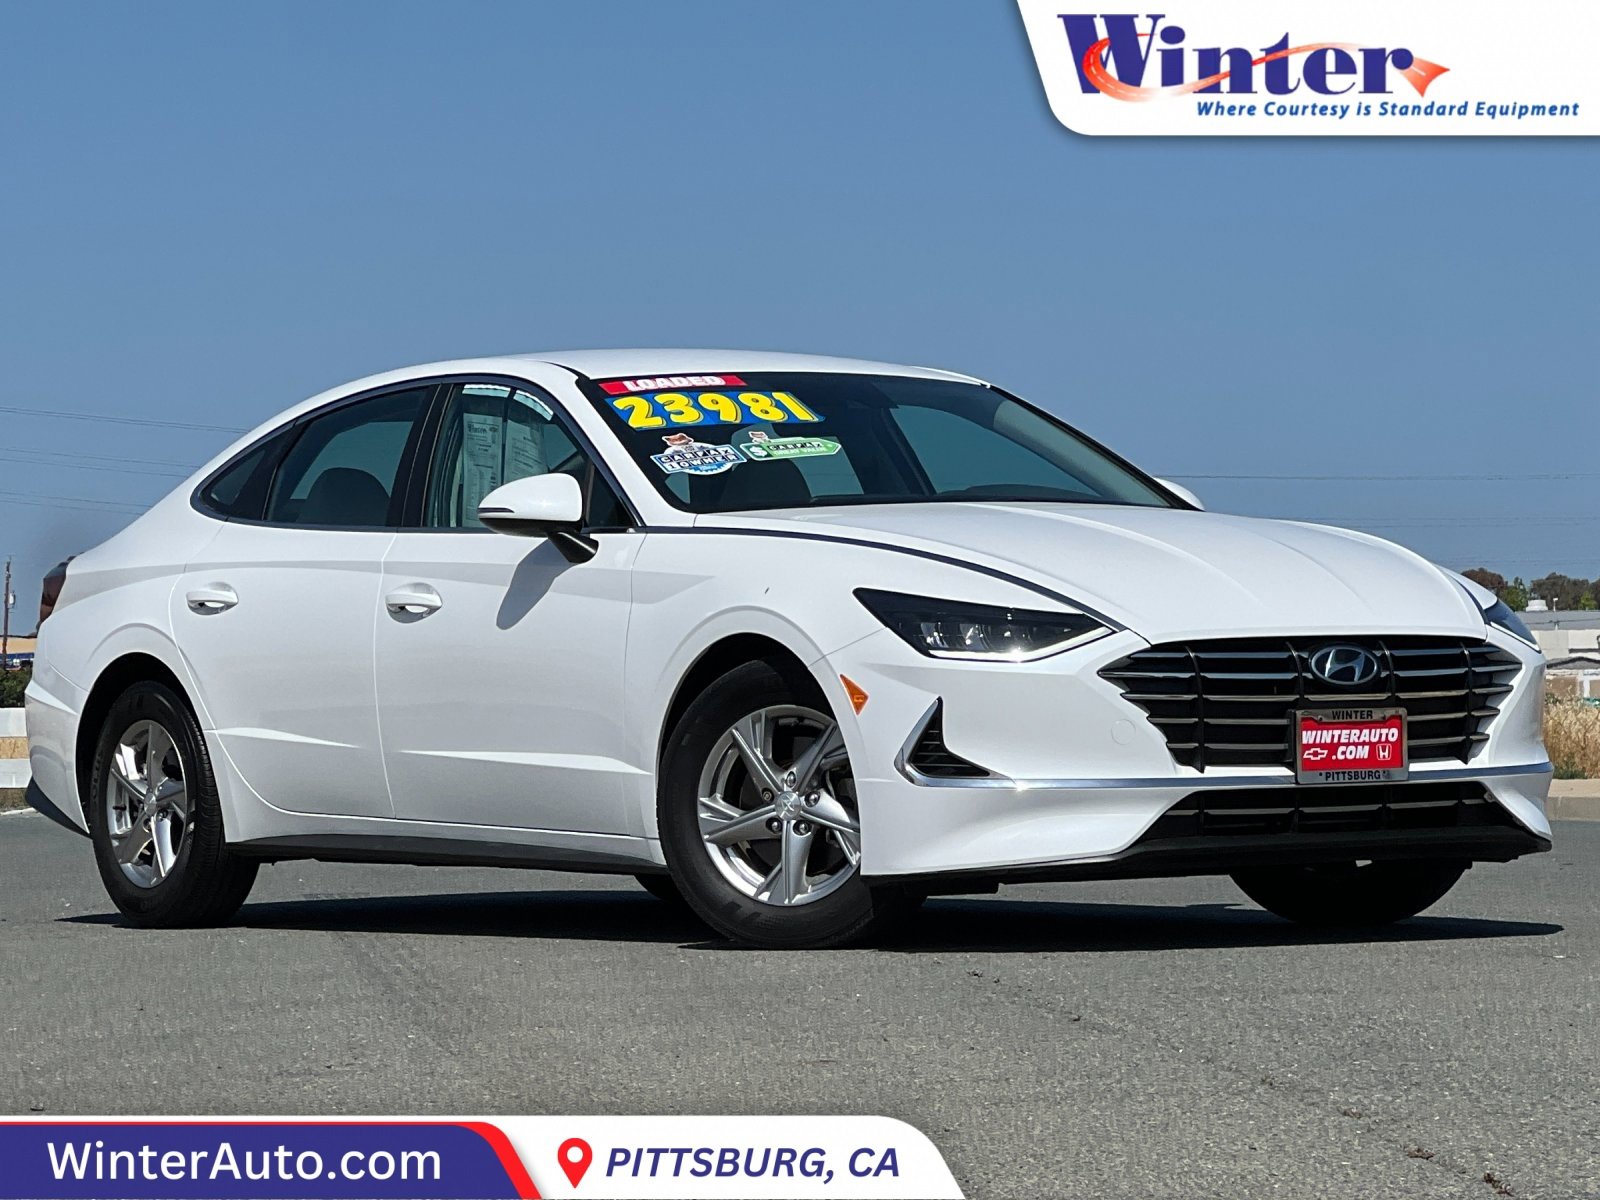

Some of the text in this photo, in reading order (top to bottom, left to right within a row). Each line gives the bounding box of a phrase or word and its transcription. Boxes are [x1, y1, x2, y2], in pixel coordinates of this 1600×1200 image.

[623, 375, 726, 392] LOADED
[612, 391, 821, 429] 23981
[660, 447, 735, 463] CARFAX
[1331, 710, 1373, 720] WINTER
[1301, 728, 1399, 744] WINTERAUTO
[1331, 745, 1369, 760] .COM
[1325, 770, 1381, 781] PITTSBURG
